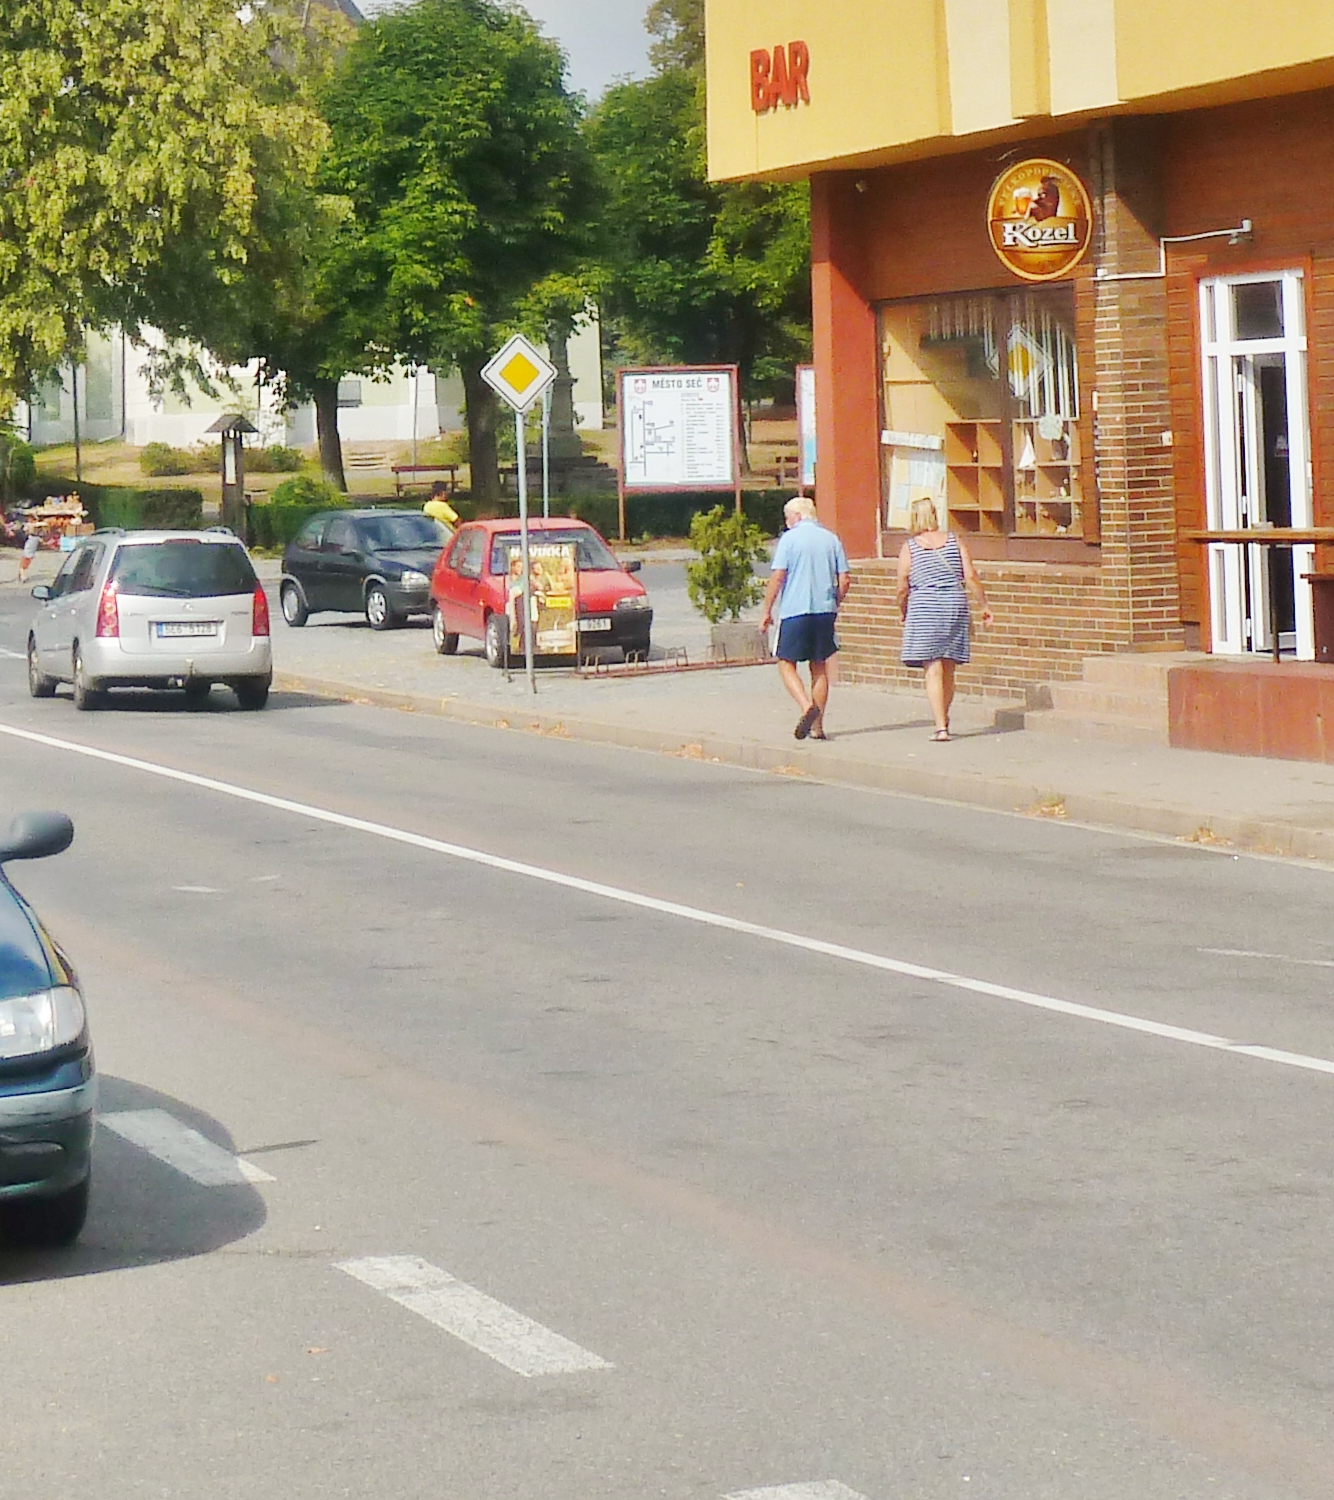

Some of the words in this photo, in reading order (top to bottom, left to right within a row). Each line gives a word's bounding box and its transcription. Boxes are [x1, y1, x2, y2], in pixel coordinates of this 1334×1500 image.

[749, 39, 810, 114] BAR
[1002, 222, 1079, 248] Kozel
[652, 377, 683, 389] MĚSTO
[685, 376, 703, 389] SEČ
[510, 546, 570, 558] NVINKA
